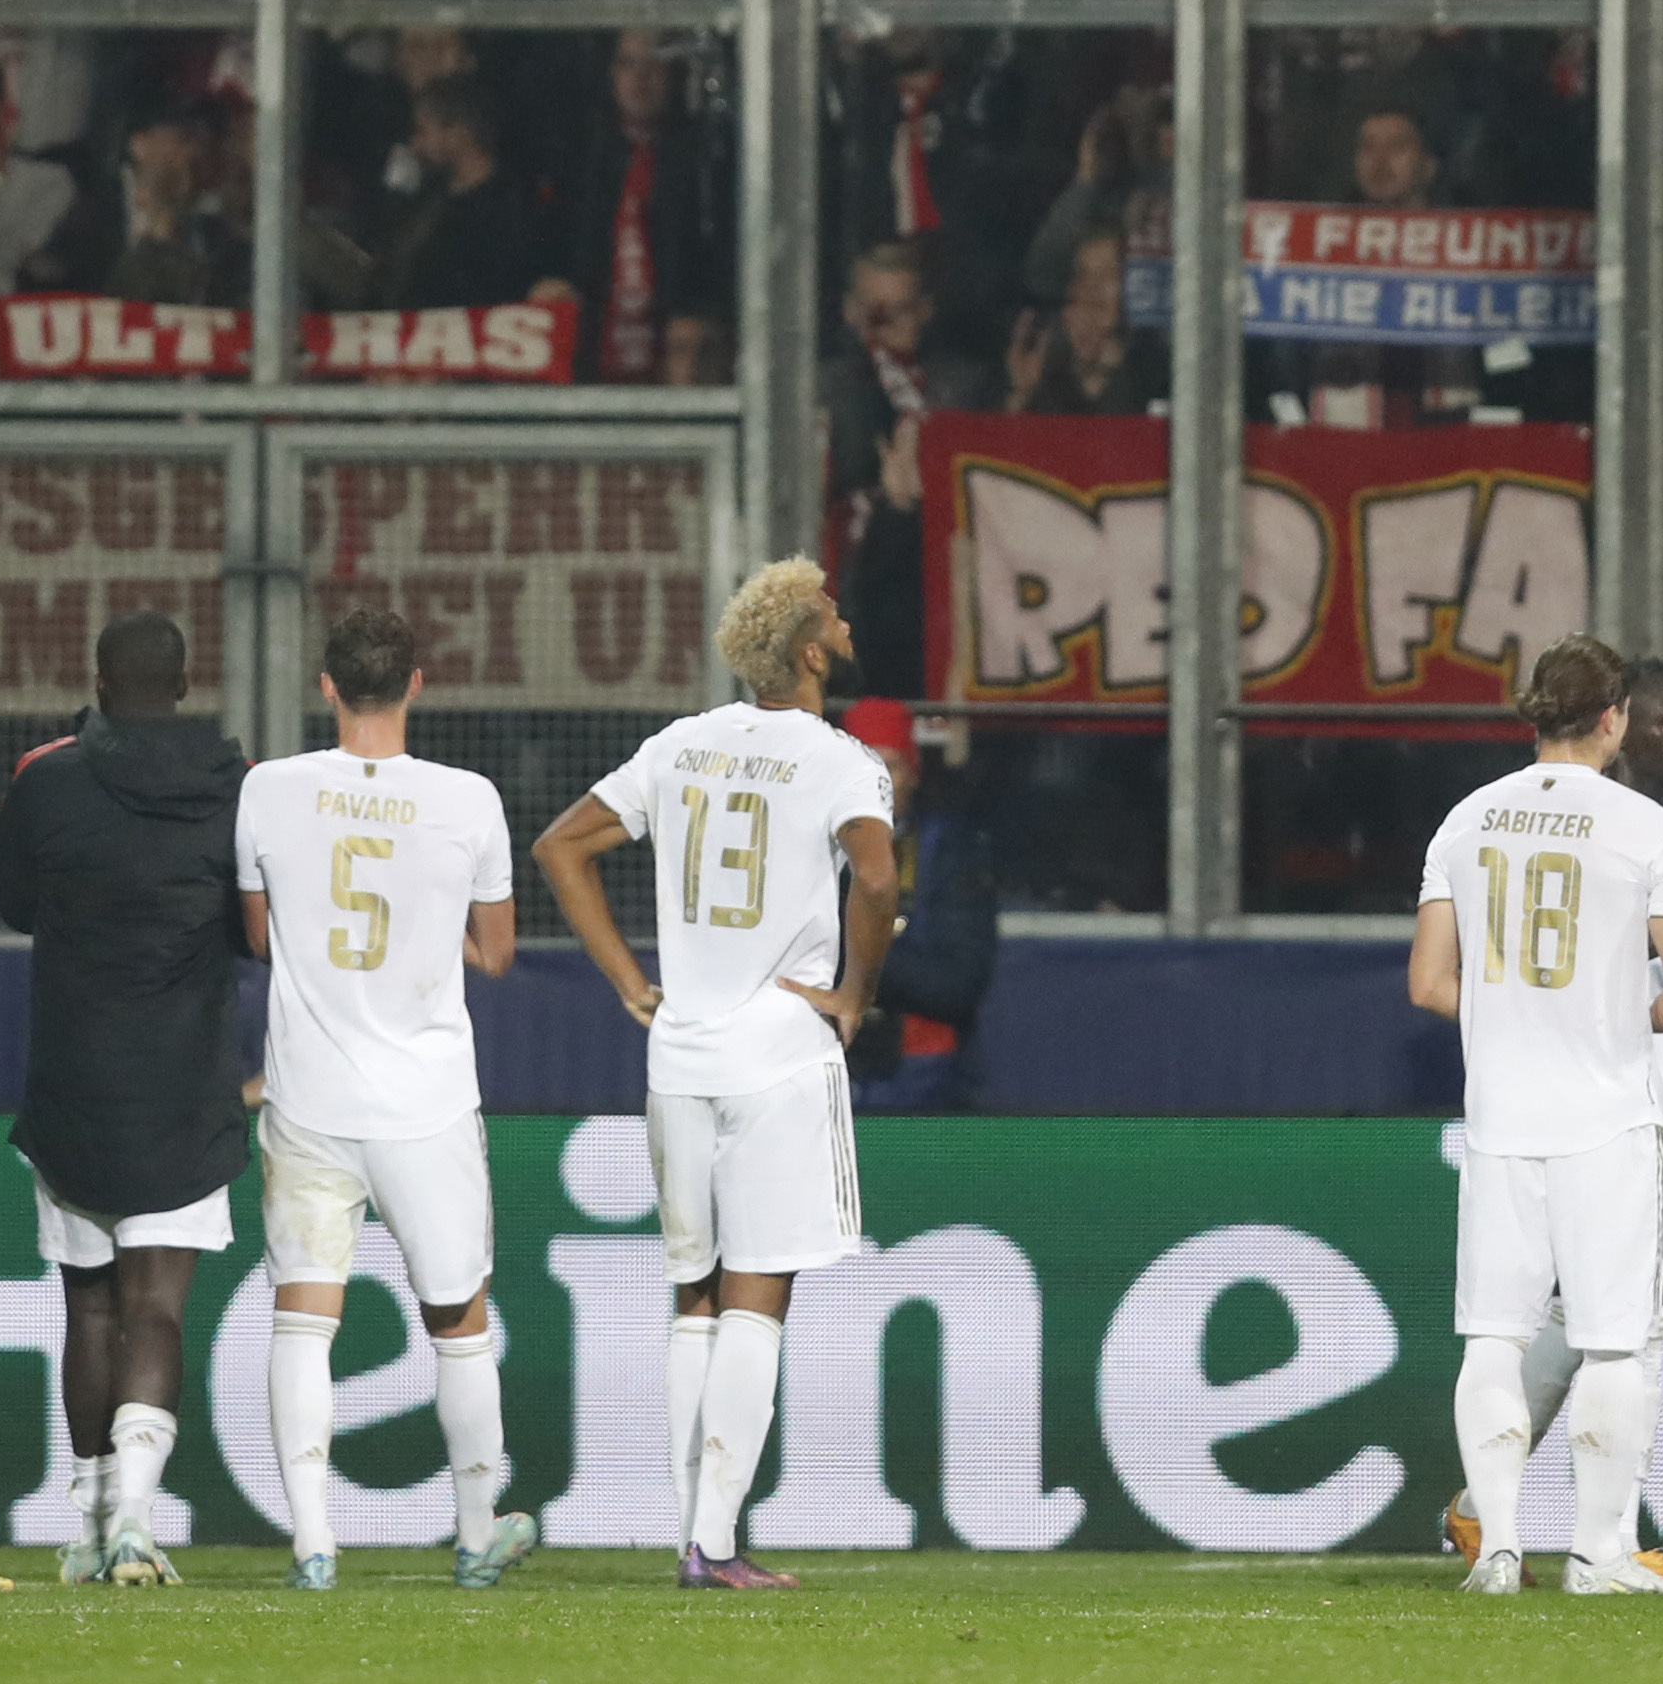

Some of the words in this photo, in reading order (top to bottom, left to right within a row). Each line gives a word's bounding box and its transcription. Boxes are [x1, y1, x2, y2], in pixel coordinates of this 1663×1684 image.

[1314, 214, 1595, 272] FREUND
[316, 789, 417, 825] PAVARD
[1480, 807, 1594, 840] SABITZER
[328, 836, 393, 971] 5
[681, 785, 769, 929] 13
[1478, 845, 1583, 989] 18
